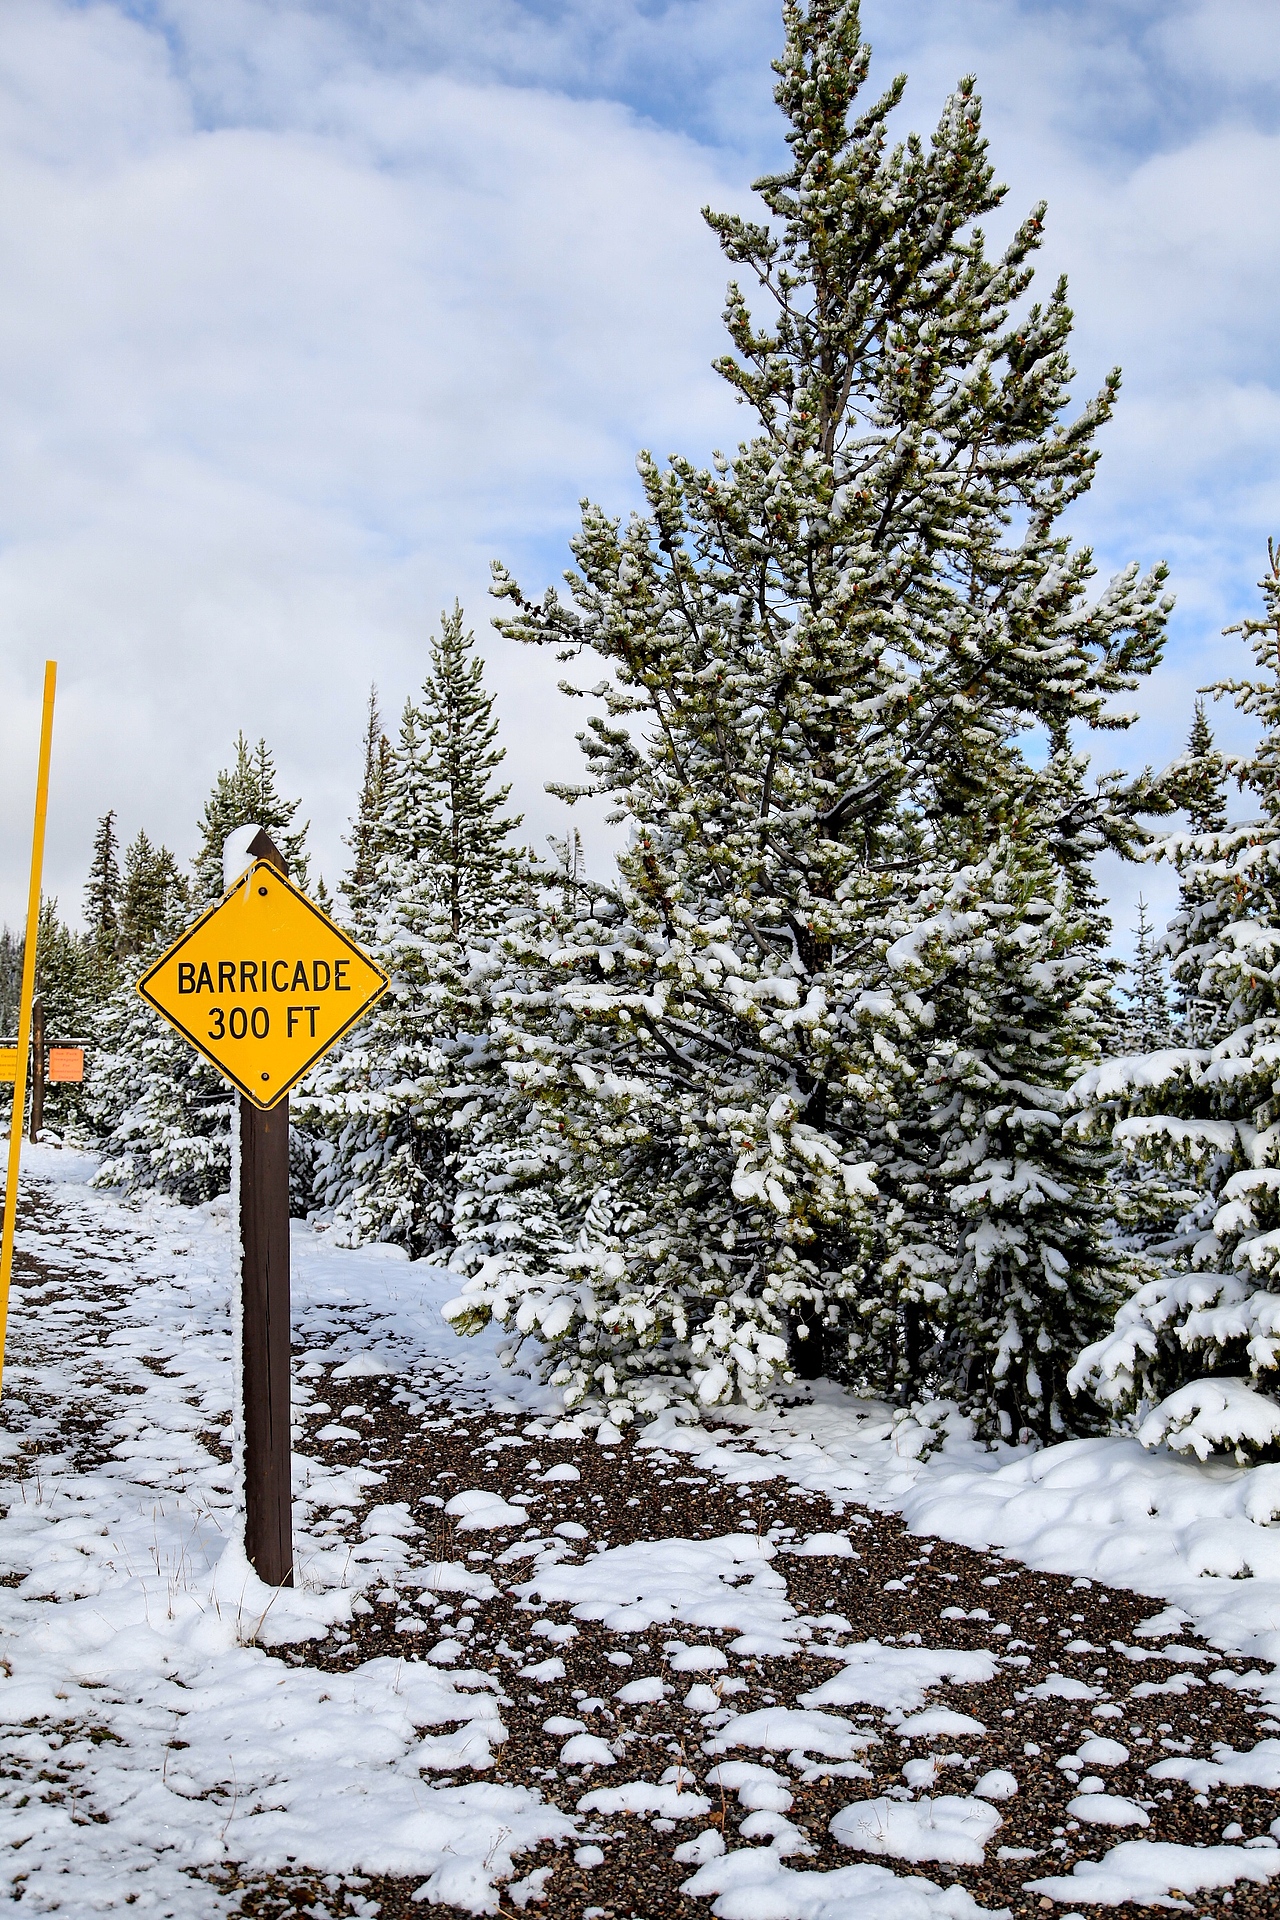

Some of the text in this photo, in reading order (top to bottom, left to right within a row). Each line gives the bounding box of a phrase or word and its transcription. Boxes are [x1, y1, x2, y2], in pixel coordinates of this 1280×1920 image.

[178, 960, 351, 993] BARRICADE
[207, 1006, 321, 1040] 300 FT
